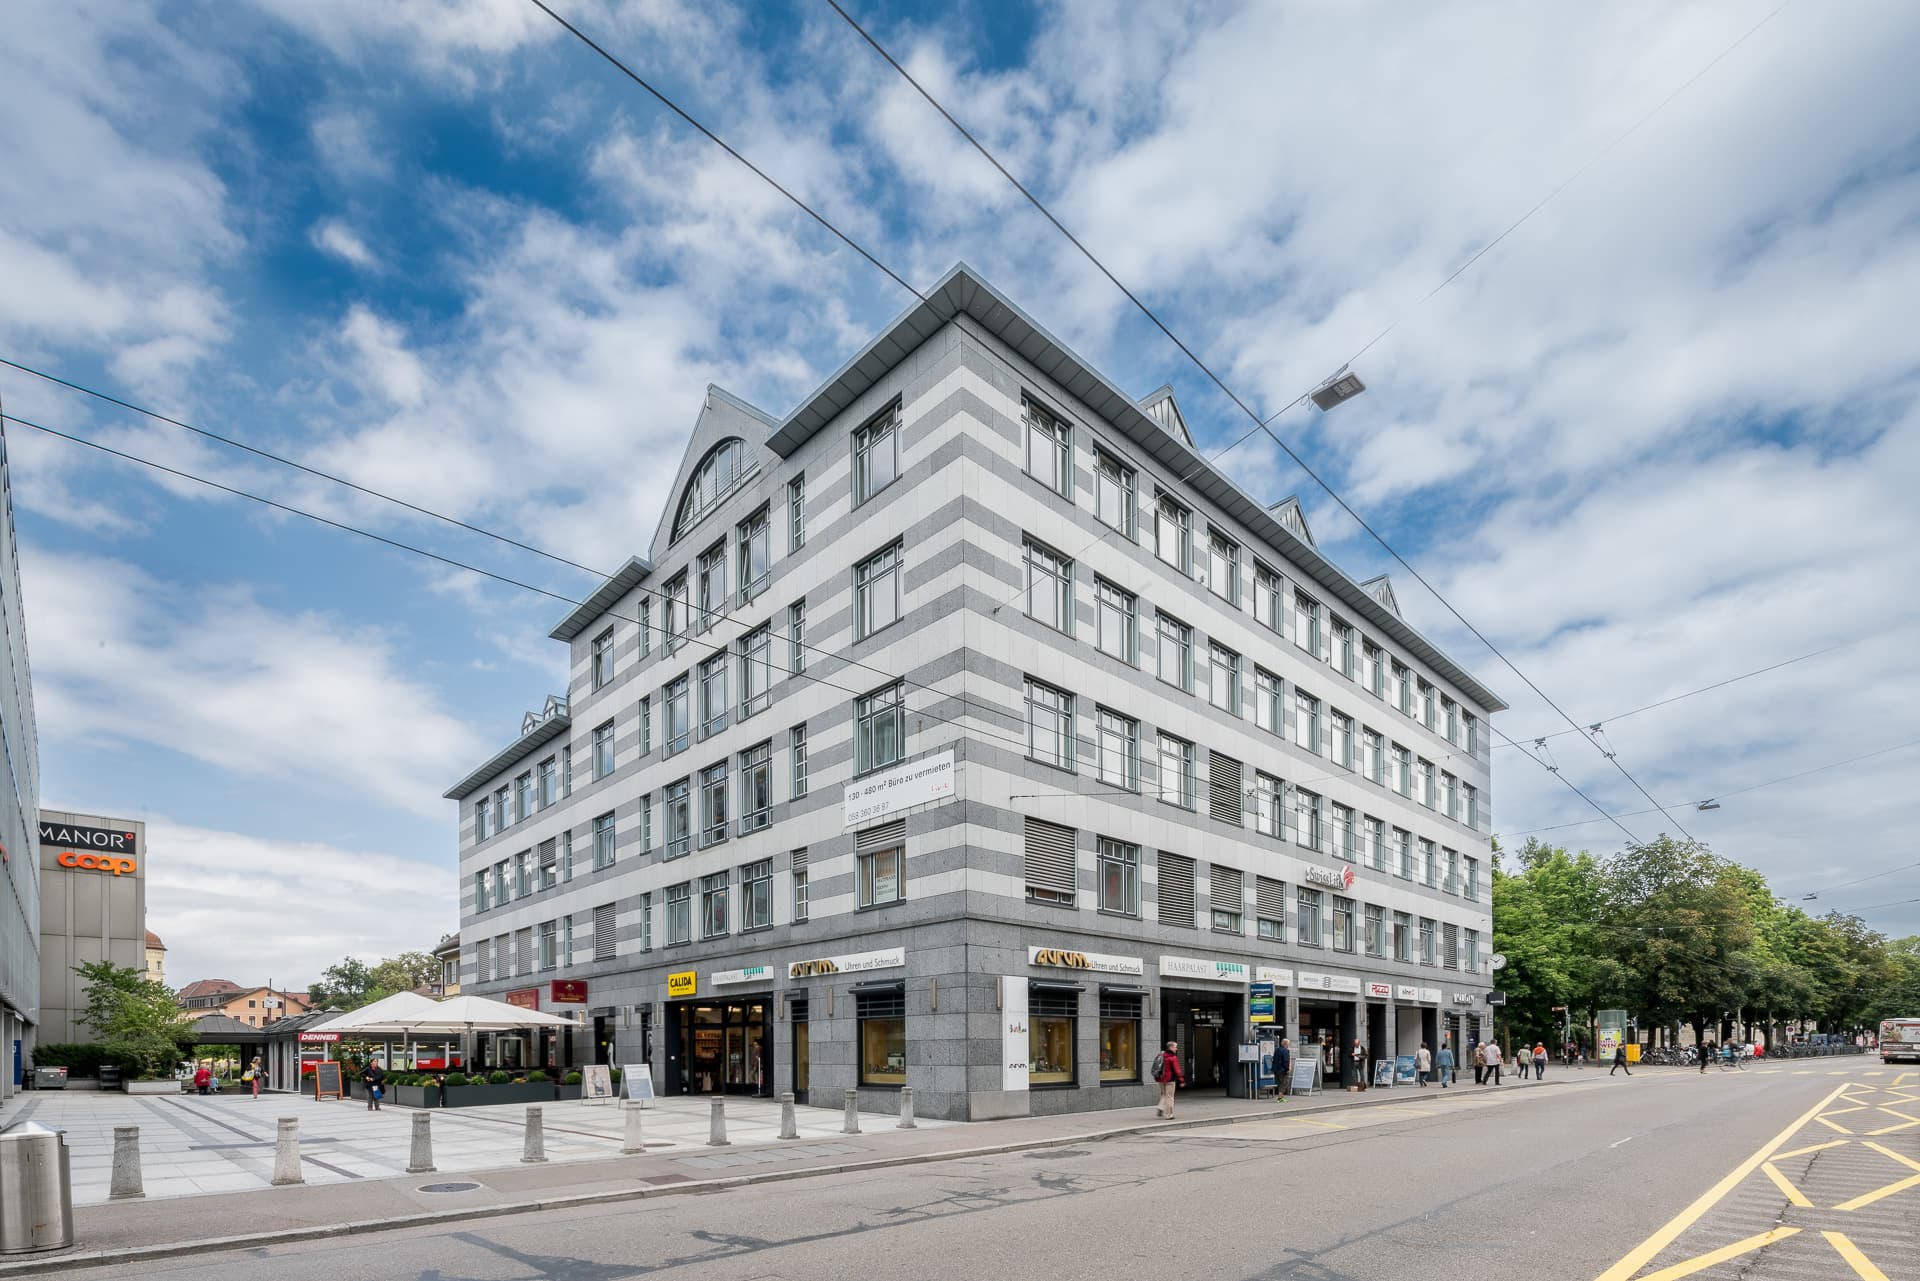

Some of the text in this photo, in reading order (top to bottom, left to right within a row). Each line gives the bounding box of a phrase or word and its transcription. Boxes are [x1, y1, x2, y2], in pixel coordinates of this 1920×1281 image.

[888, 777, 904, 788] Büro
[905, 774, 913, 782] zu
[914, 761, 951, 779] vermieten
[40, 826, 124, 849] MANOR
[58, 851, 136, 876] coop
[844, 960, 861, 971] Uhren
[863, 959, 873, 969] und
[874, 955, 900, 968] Schmuck
[1091, 960, 1107, 970] Uhren
[1109, 962, 1118, 971] und
[1120, 962, 1141, 973] Schmuck
[670, 976, 692, 988] CALIDA
